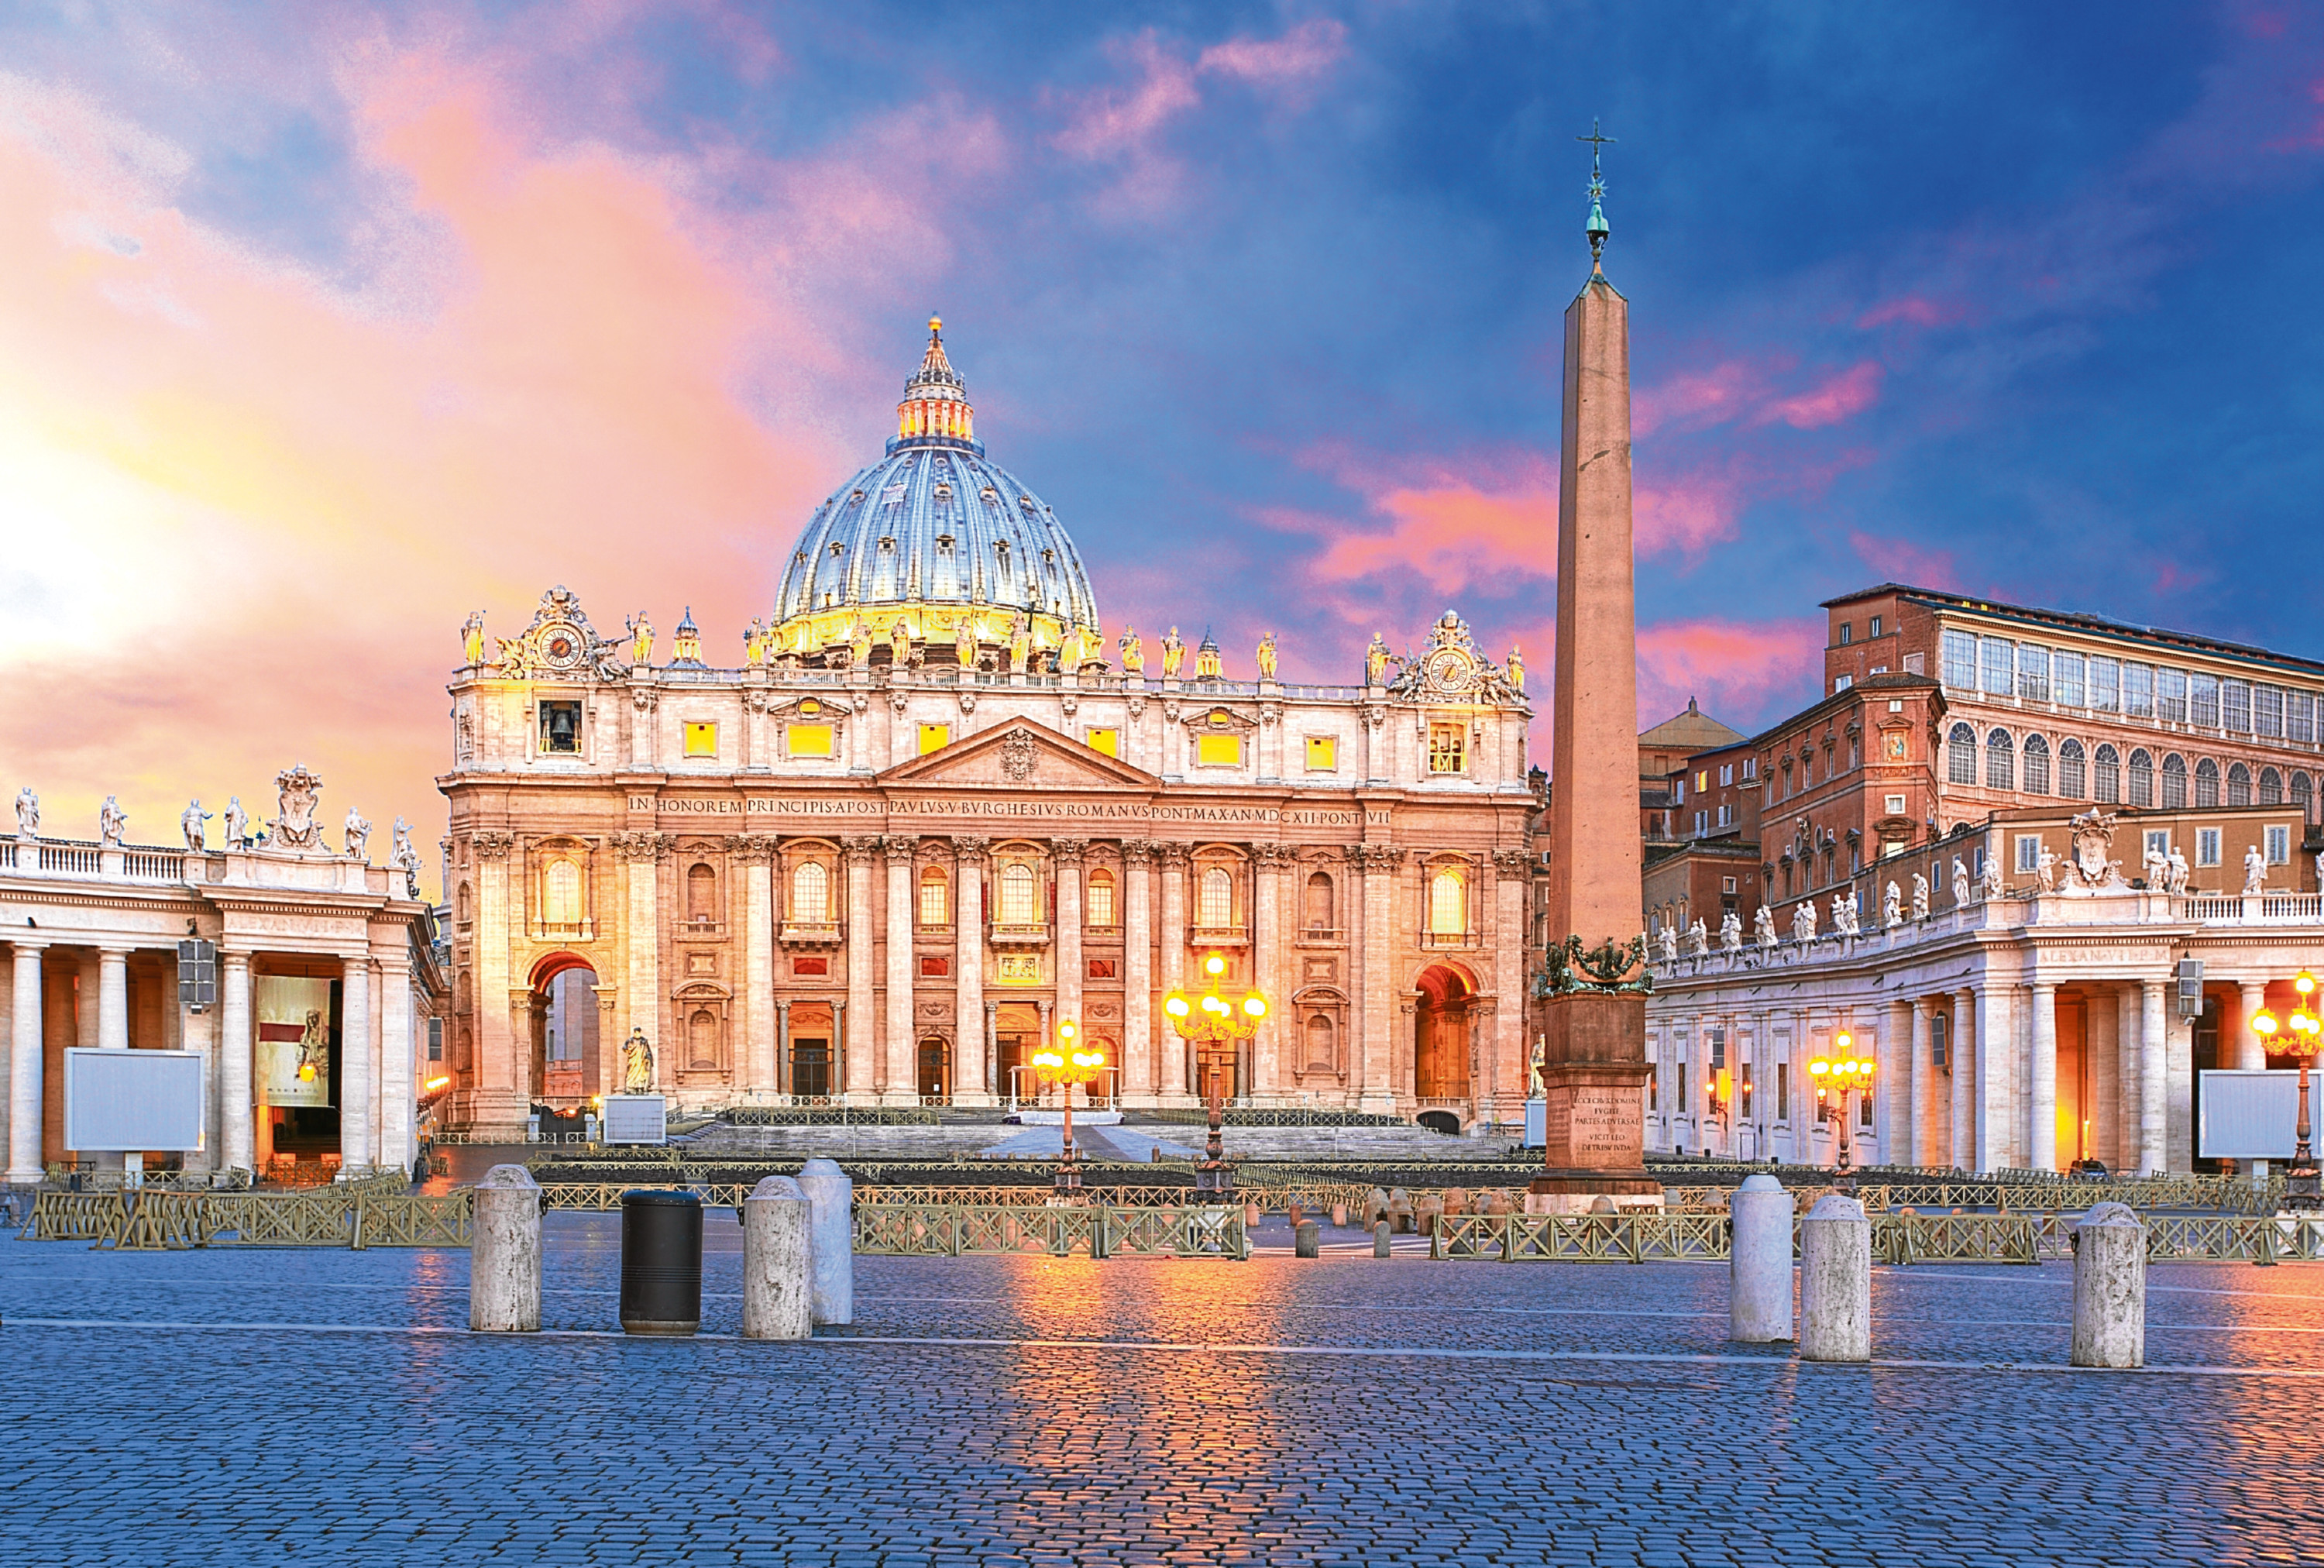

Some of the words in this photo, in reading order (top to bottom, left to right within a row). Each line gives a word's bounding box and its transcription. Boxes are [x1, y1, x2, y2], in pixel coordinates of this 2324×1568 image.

[629, 797, 648, 810] IN
[655, 799, 742, 813] HONOREM
[748, 799, 832, 813] PRINCIPIS
[835, 801, 886, 813] APOST
[889, 800, 944, 813] PAVLVS
[947, 801, 957, 813] V
[961, 802, 1062, 816] BVRGHESIVS
[1067, 805, 1149, 817] ROMANVS
[1151, 806, 1191, 819] PONT
[1193, 808, 1227, 820] MAX
[1230, 809, 1251, 821] AN
[1320, 812, 1361, 824] PONT
[1367, 812, 1390, 824] VII
